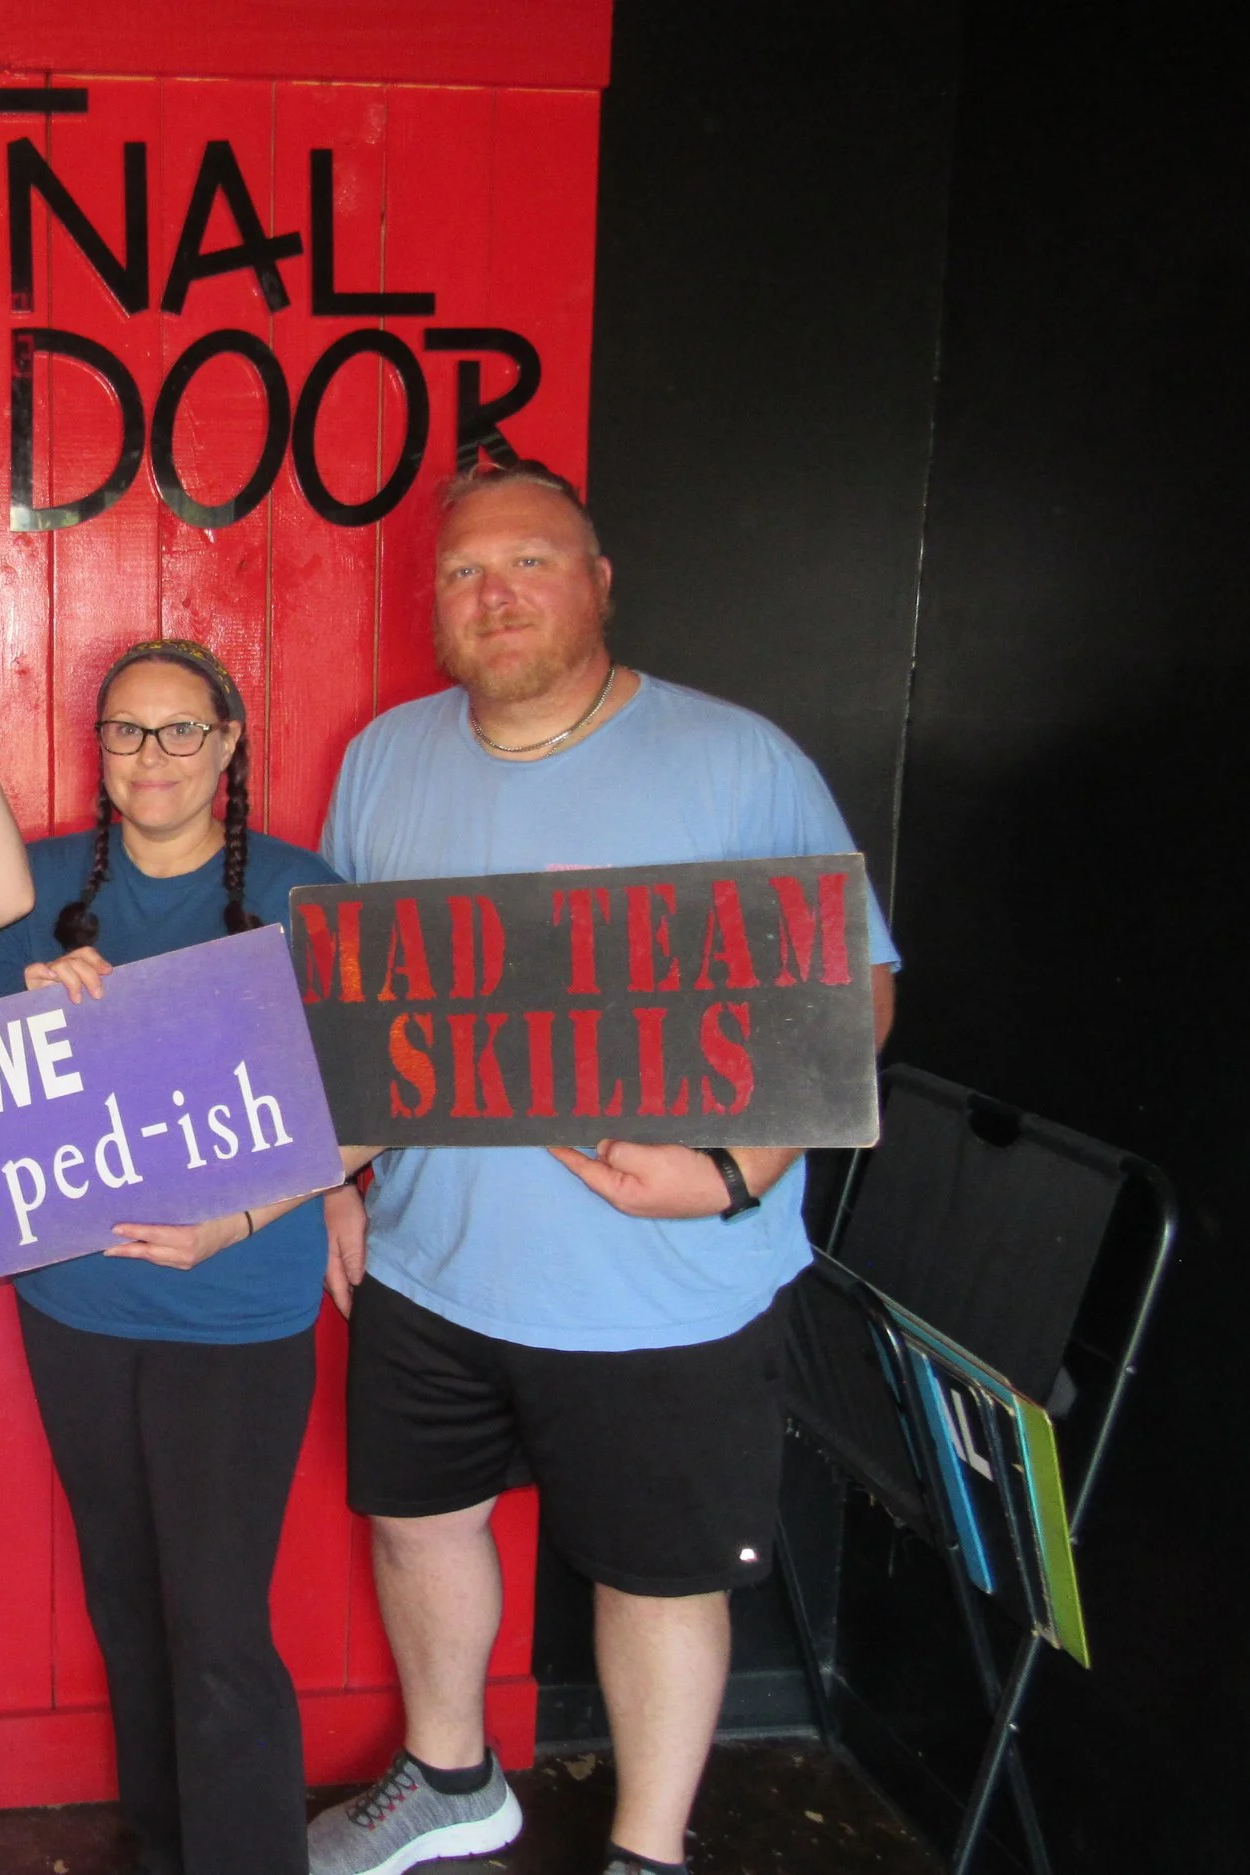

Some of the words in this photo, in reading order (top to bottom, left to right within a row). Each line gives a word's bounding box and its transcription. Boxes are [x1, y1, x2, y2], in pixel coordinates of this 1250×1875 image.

[10, 326, 543, 533] DOOR
[297, 894, 506, 1005] MAD
[553, 872, 854, 996] TEAM
[388, 1000, 755, 1119] SKILLS
